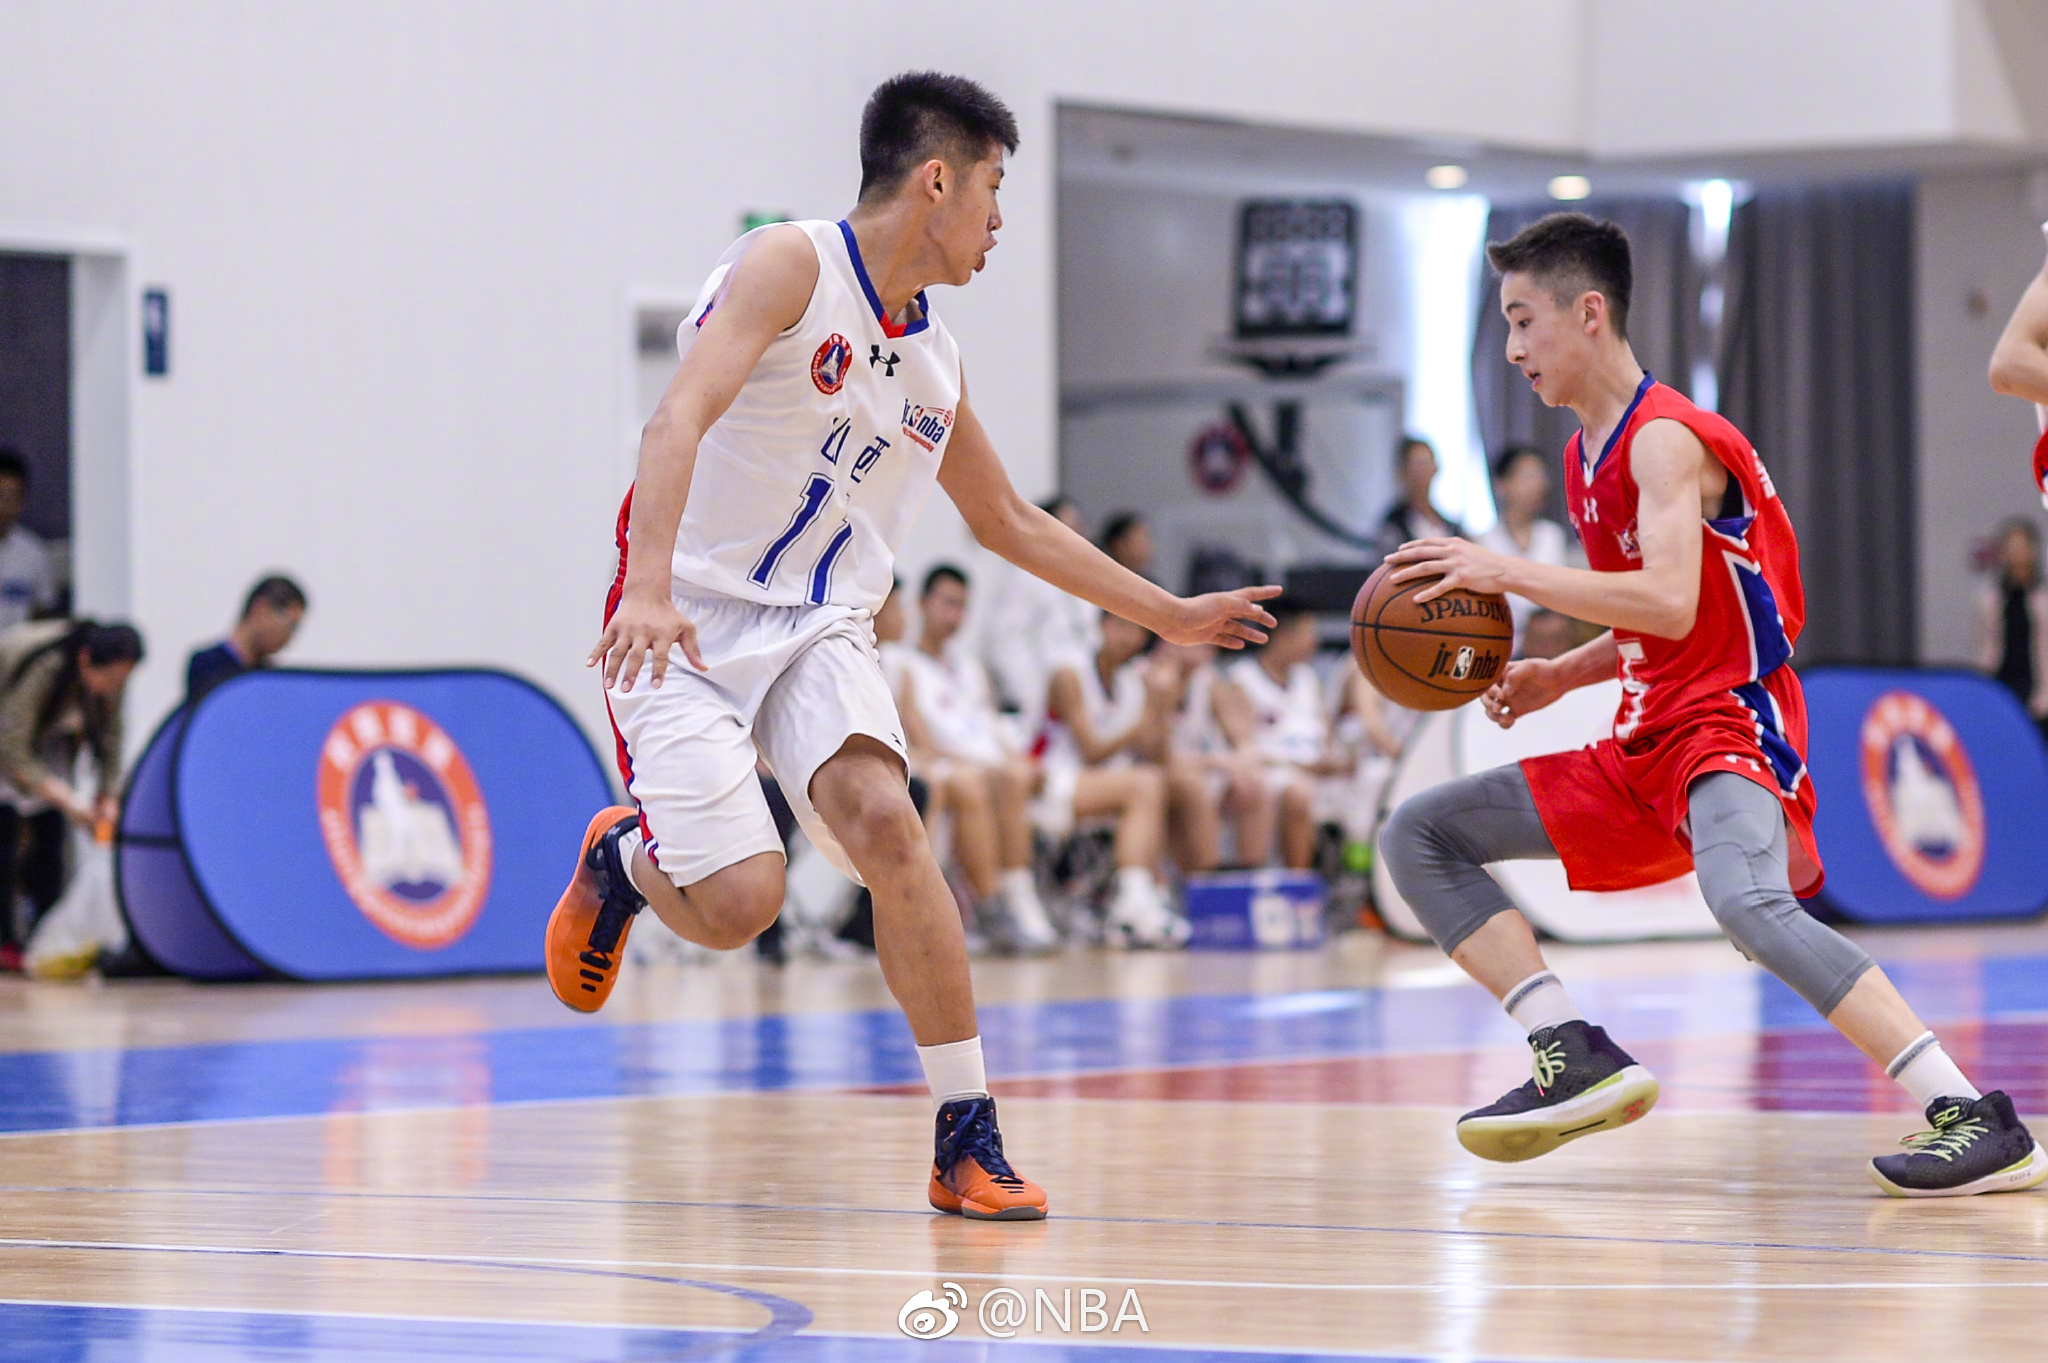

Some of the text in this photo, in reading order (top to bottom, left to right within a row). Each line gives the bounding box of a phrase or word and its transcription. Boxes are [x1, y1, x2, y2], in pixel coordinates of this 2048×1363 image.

[916, 415, 946, 444] nba
[747, 472, 854, 605] 11
[1421, 597, 1512, 628] SPALDIN
[1428, 642, 1500, 680] jr. nba
